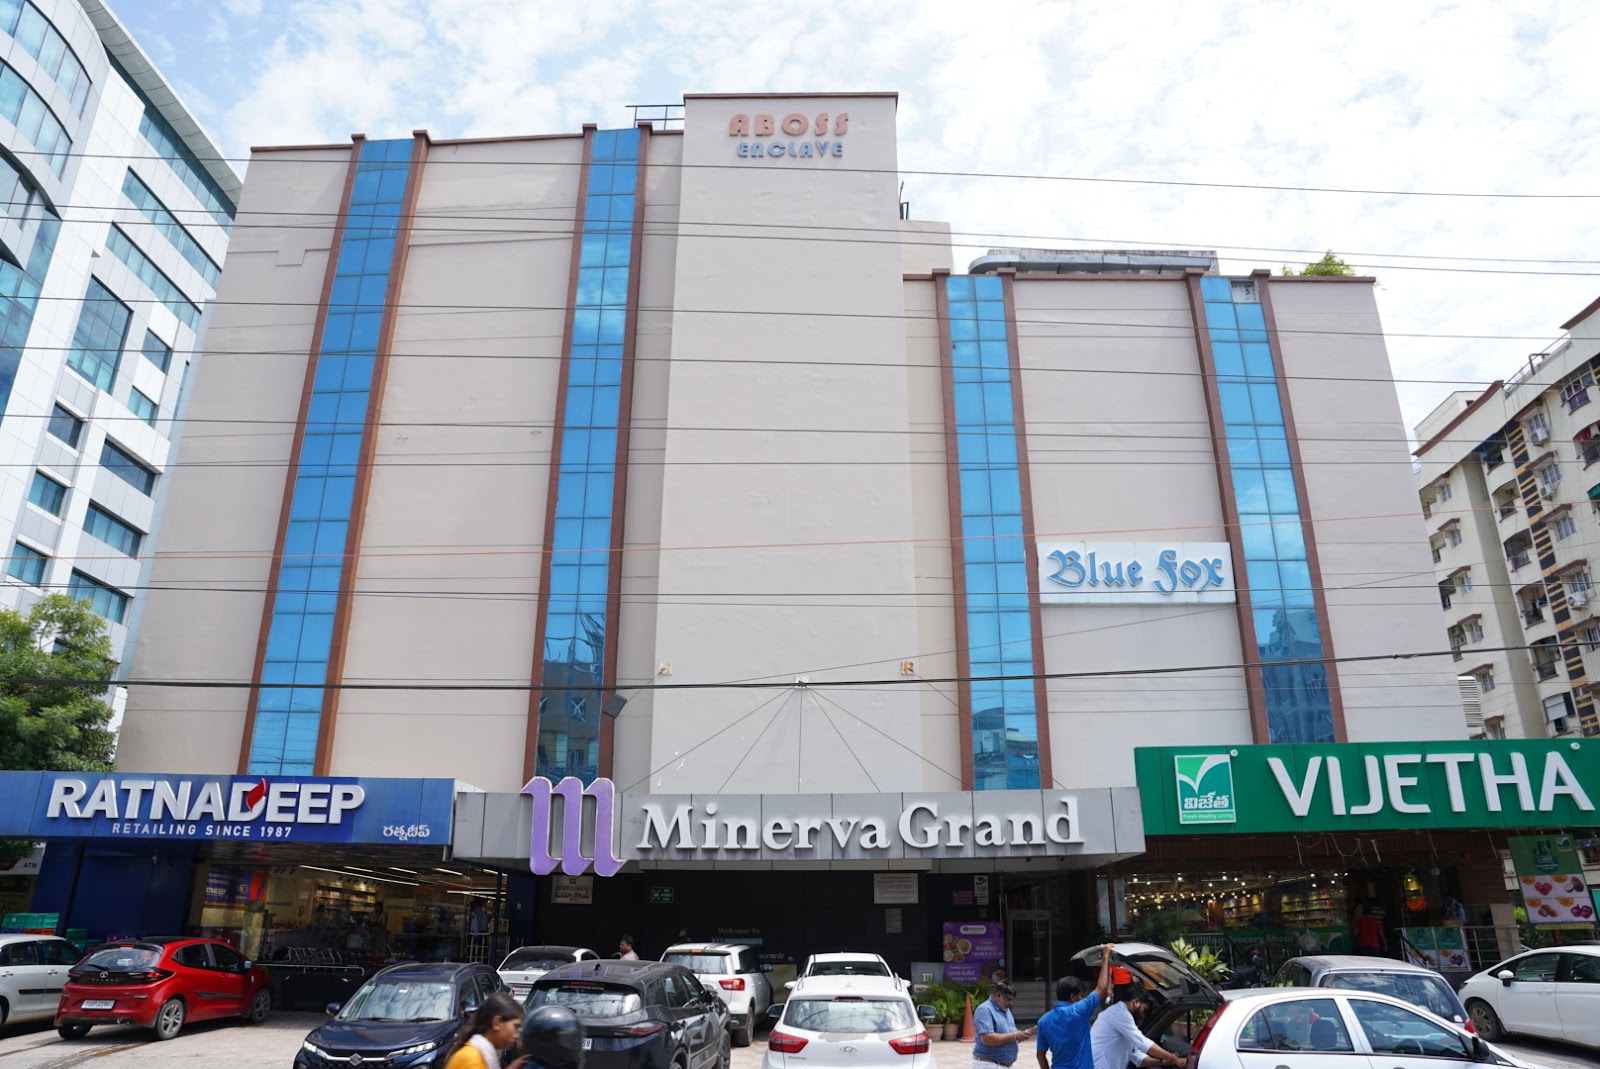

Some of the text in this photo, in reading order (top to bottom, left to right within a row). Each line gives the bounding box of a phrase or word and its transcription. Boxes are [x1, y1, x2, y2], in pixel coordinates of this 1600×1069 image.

[729, 113, 849, 137] ABOSS
[1047, 549, 1225, 595] Blue Fox
[46, 778, 365, 824] RATNADEEP
[1184, 791, 1230, 809] విజేత
[1266, 751, 1597, 816] VIJETHA
[112, 823, 292, 837] RETAILING SINCE 1987
[635, 797, 1085, 850] Minerva Grand
